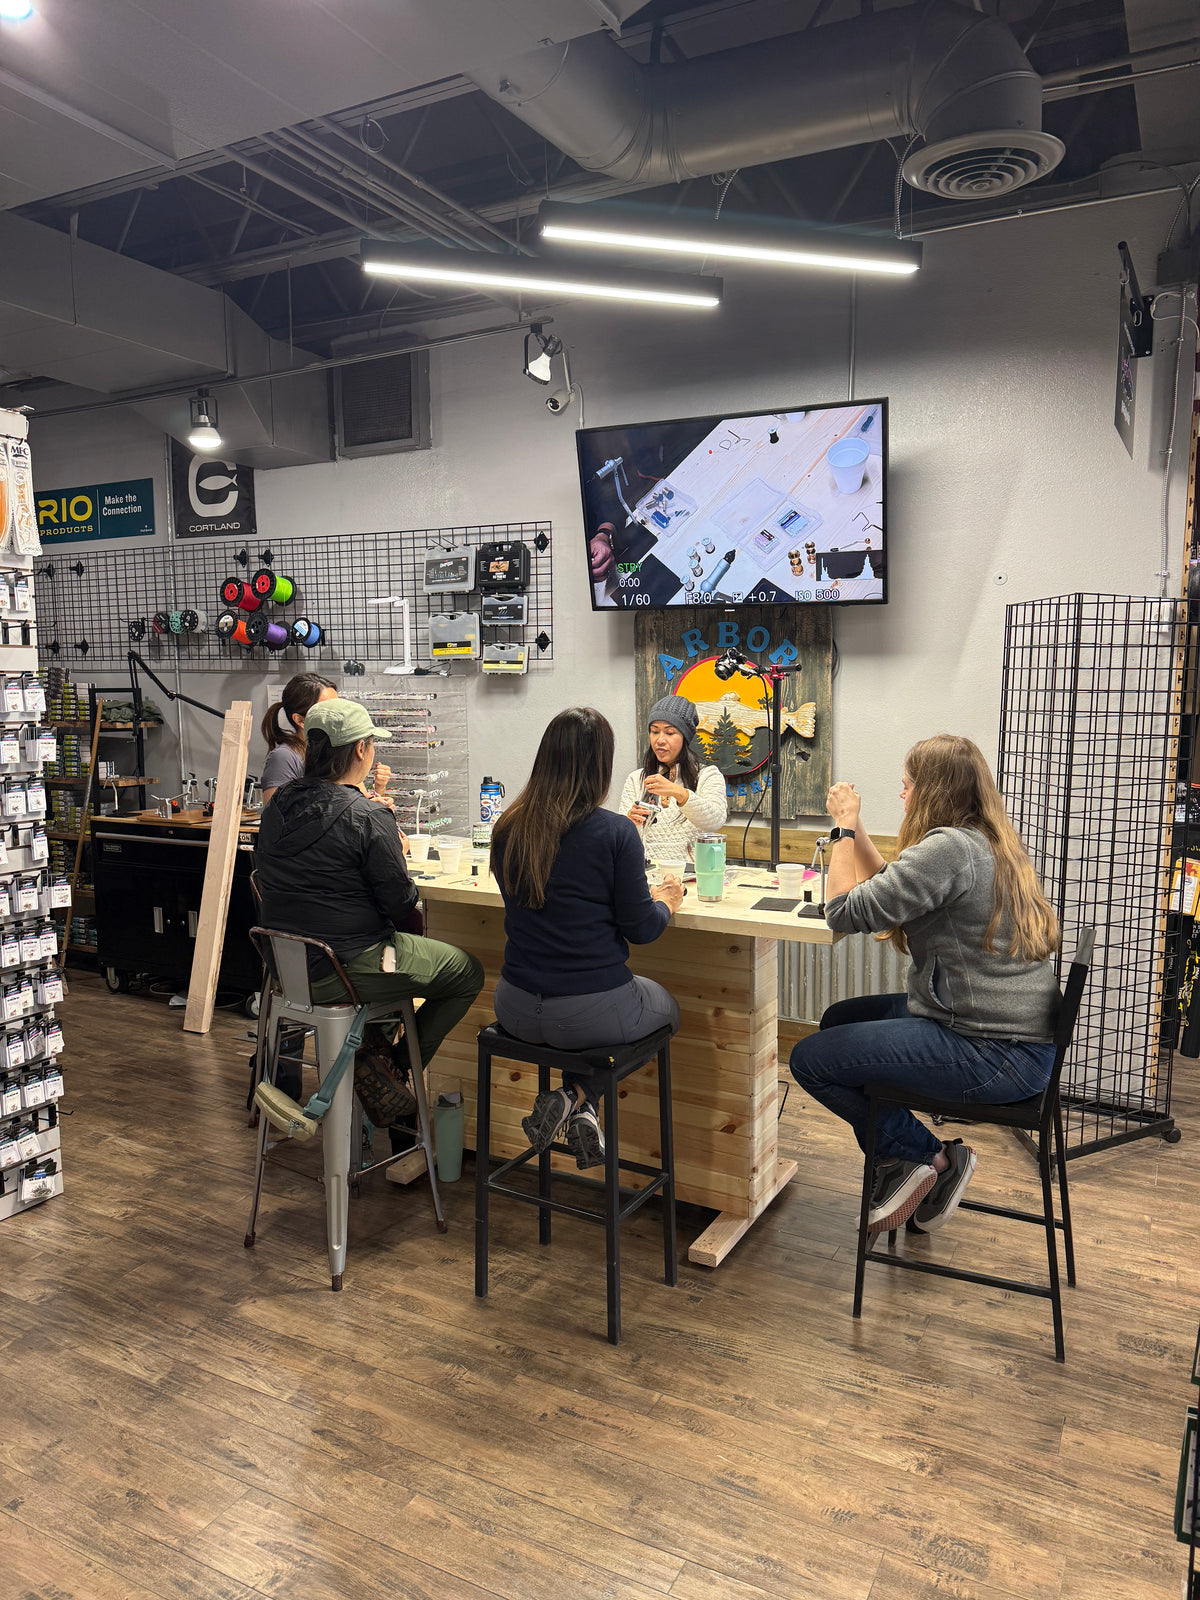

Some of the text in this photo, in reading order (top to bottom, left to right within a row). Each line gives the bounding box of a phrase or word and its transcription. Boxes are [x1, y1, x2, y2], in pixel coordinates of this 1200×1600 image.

[11, 445, 29, 456] MFC
[104, 493, 137, 505] Make the
[37, 495, 93, 525] RIO
[102, 504, 142, 516] Connection
[40, 525, 94, 536] PRODUCTS
[188, 521, 241, 533] CORTLAND
[617, 562, 643, 573] STBY
[619, 577, 640, 588] 0:00
[621, 593, 651, 606] 1/60
[795, 590, 812, 600] ISO
[816, 588, 840, 600] 500
[658, 621, 799, 681] ARBOR
